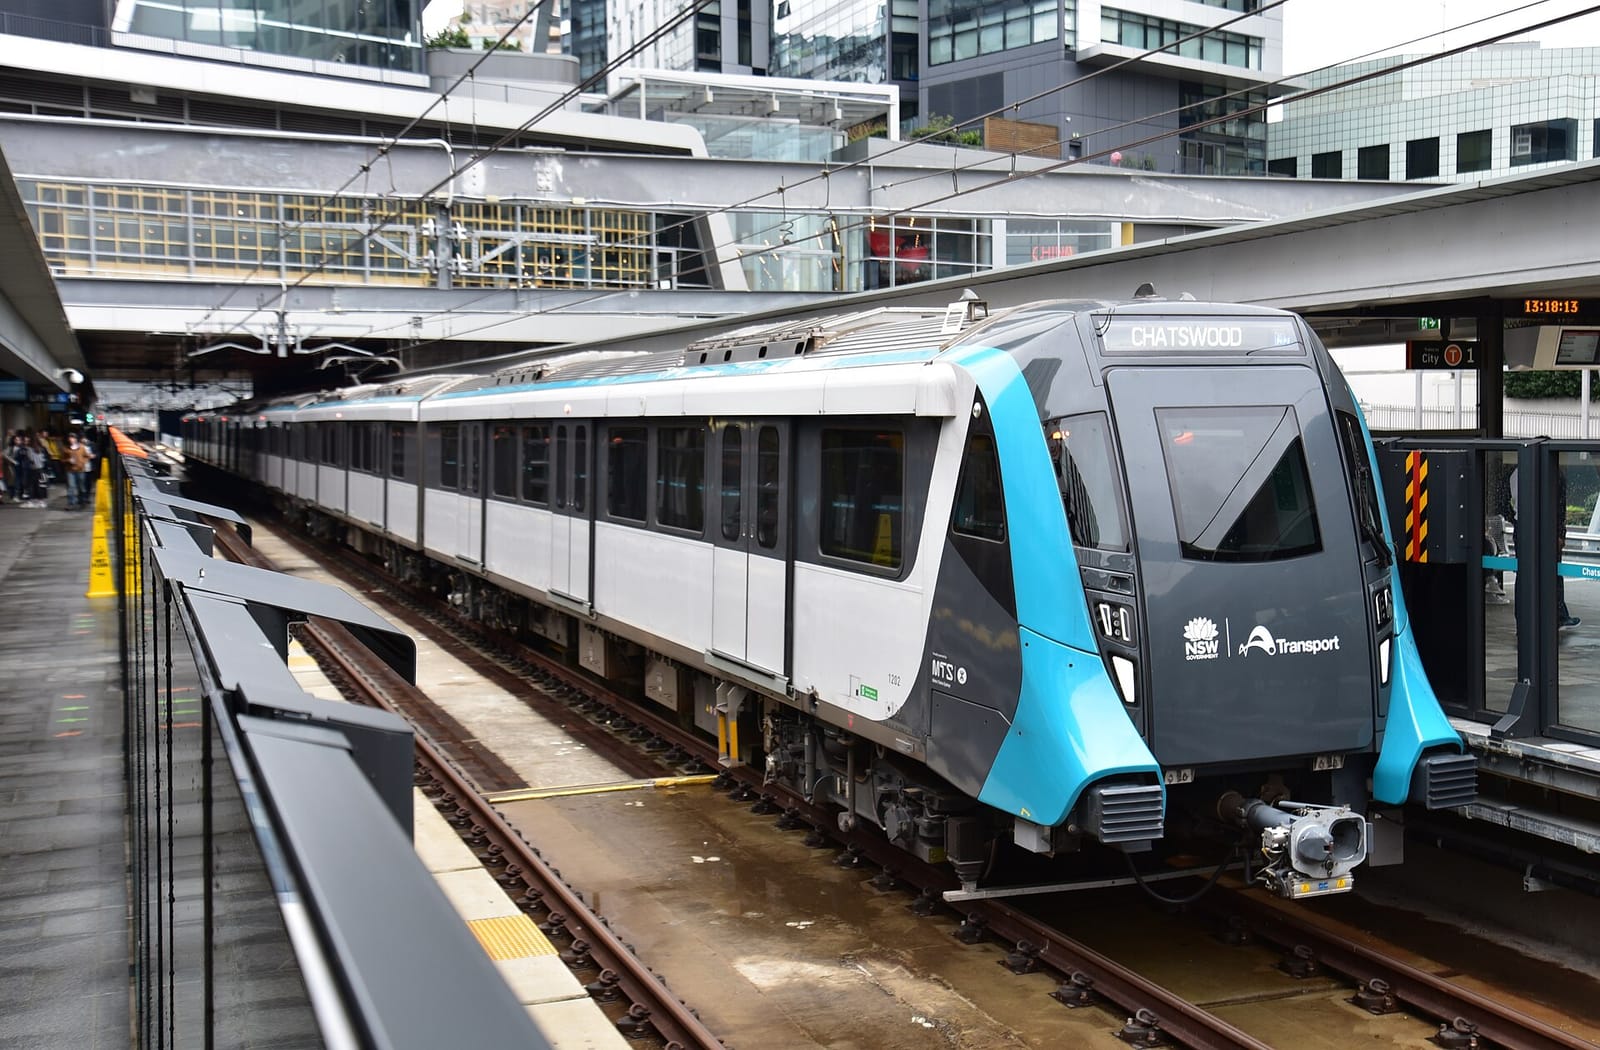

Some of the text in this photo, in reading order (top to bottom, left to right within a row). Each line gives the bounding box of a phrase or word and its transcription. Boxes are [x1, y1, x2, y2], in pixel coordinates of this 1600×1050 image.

[1525, 300, 1579, 313] 13:18:13
[1131, 326, 1242, 347] CHATSWOOD
[1422, 353, 1440, 365] City
[1467, 347, 1475, 364] 1
[1185, 639, 1219, 655] NSW
[1275, 635, 1340, 655] Transport
[1185, 653, 1219, 661] GOVERNMENT
[932, 659, 954, 682] MTS
[888, 673, 901, 687] 1202
